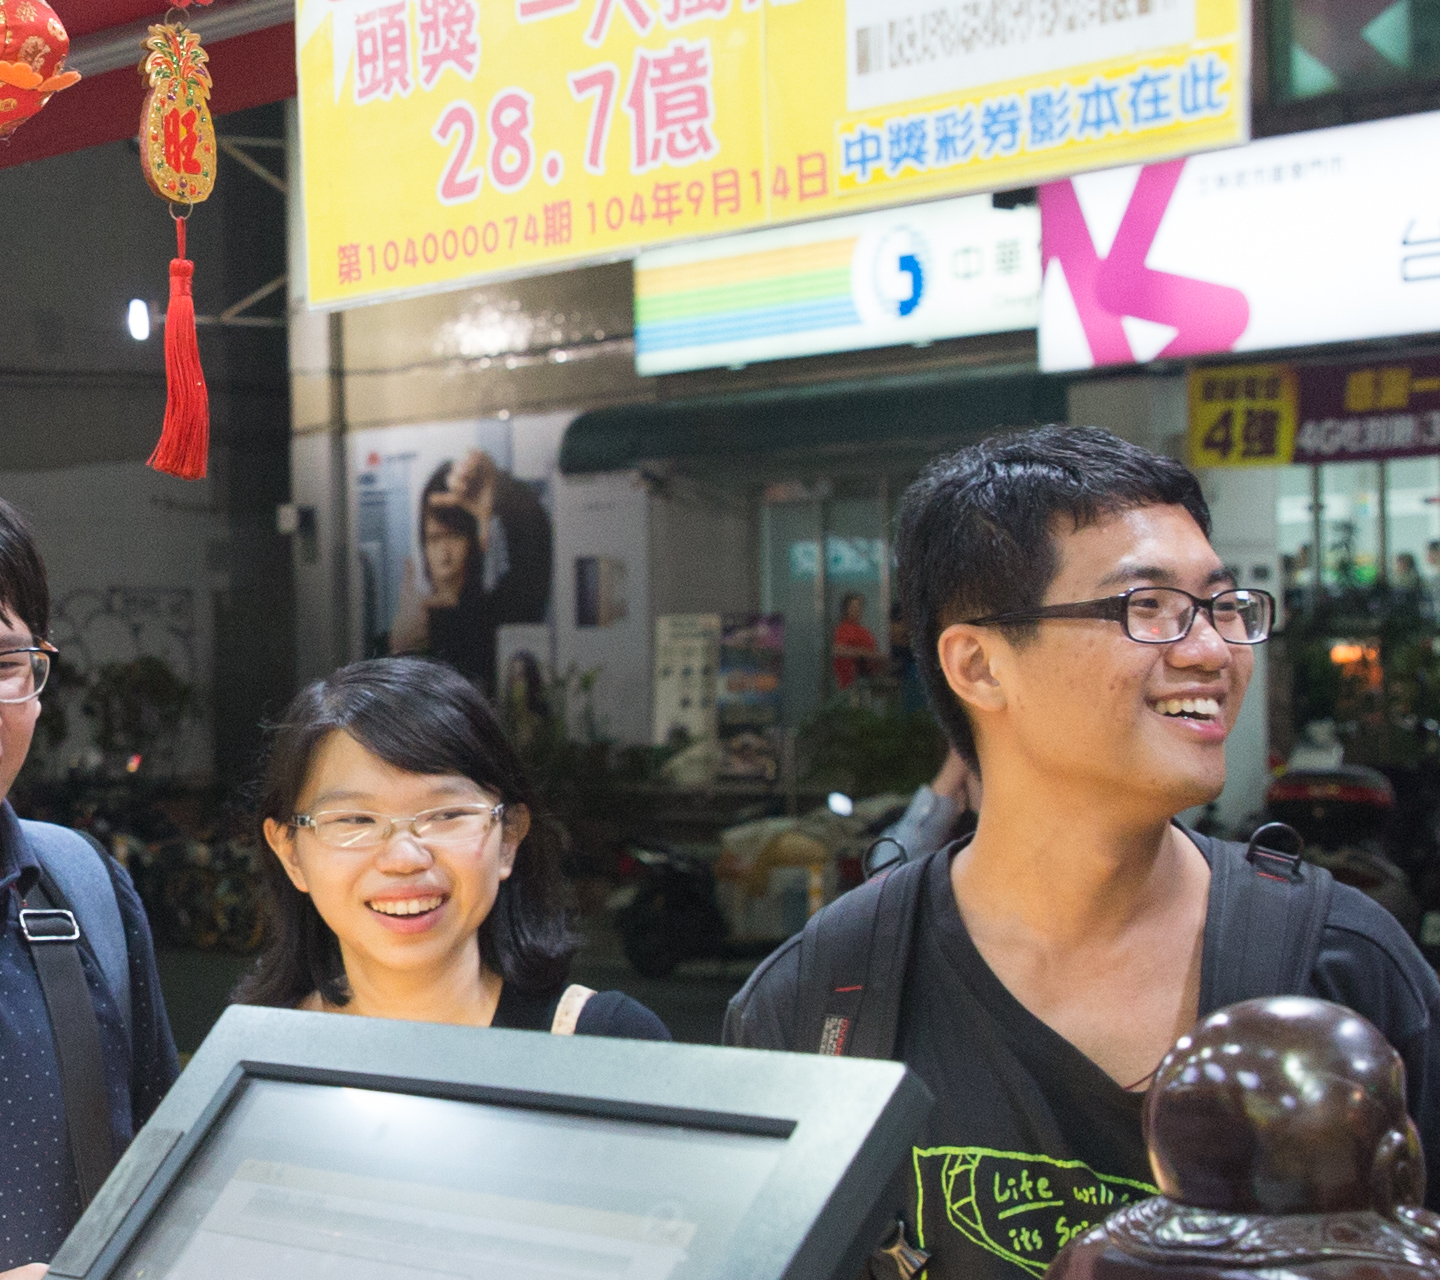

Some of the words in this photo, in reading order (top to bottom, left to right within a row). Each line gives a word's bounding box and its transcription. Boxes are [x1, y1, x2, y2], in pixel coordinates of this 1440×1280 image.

[159, 110, 202, 178] 旺
[437, 45, 714, 201] 28.7億
[841, 57, 1229, 180] 中獎彩券影本在此
[338, 200, 572, 284] 第104000074期
[587, 152, 828, 233] 104年9月14日
[1073, 1182, 1115, 1206] will
